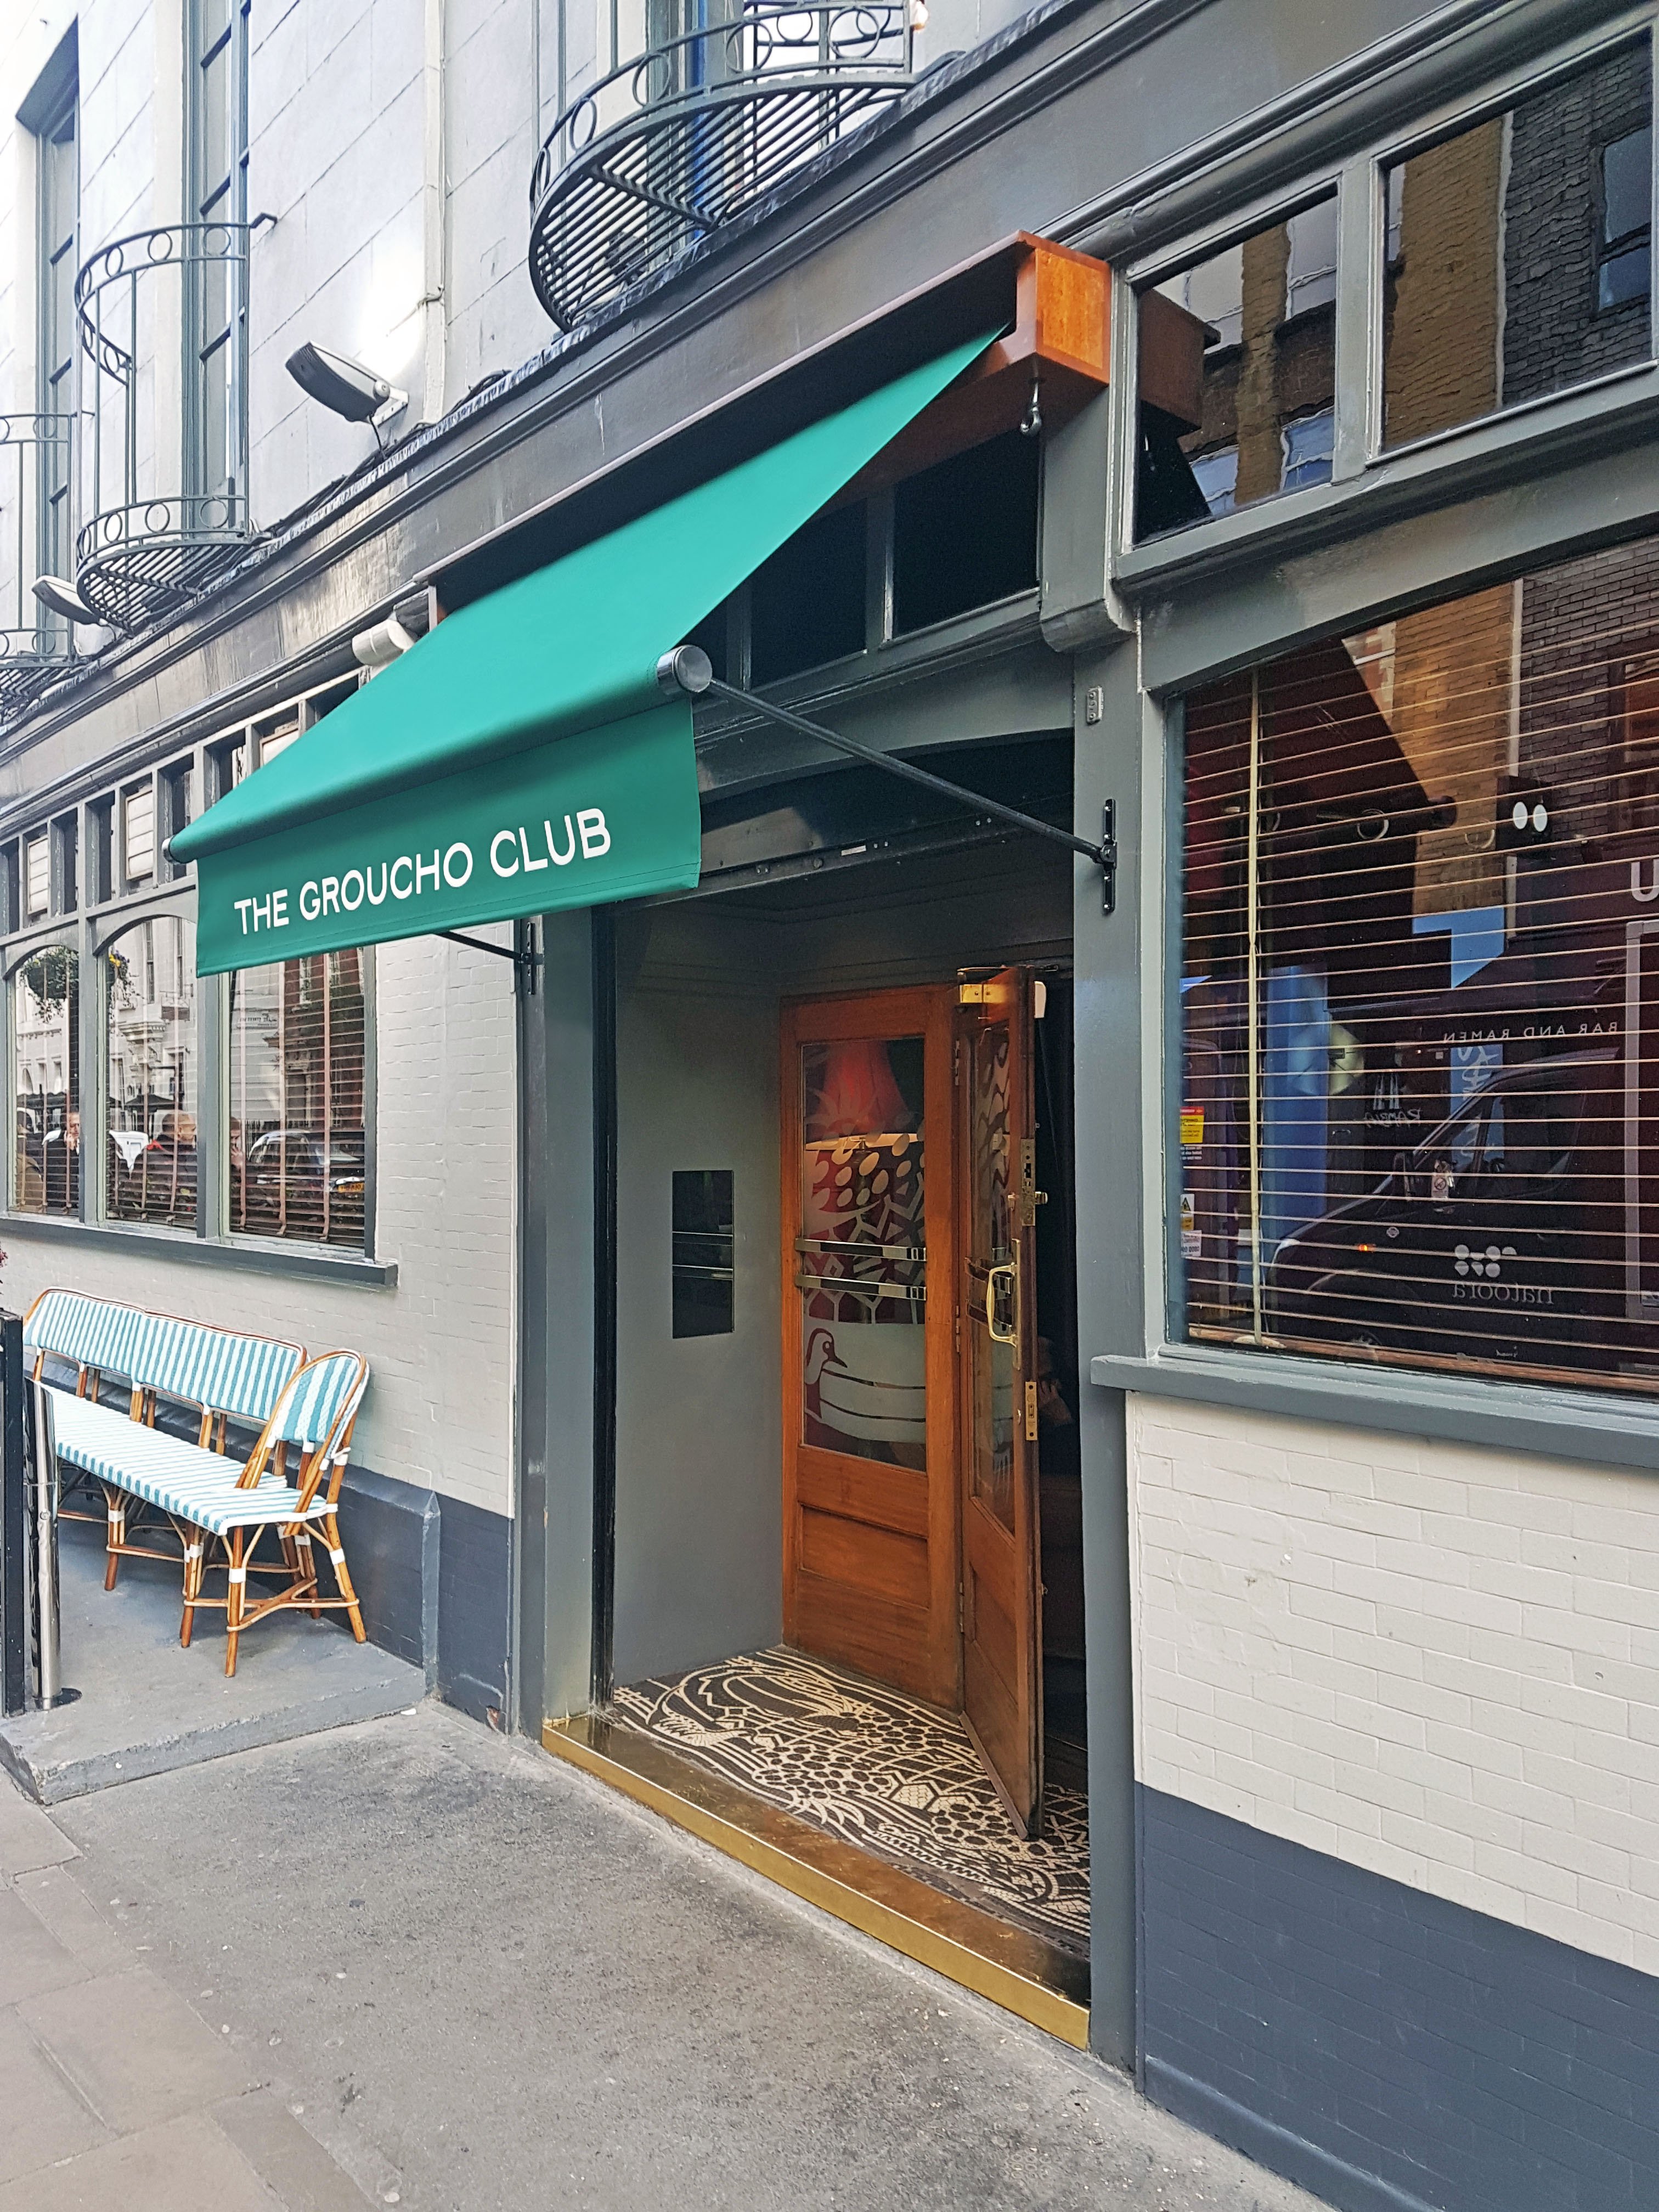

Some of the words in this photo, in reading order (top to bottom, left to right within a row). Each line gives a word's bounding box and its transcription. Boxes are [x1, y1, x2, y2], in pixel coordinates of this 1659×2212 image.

[234, 889, 289, 935] THE
[299, 842, 473, 921] GROUCHO
[490, 808, 612, 878] CLUB
